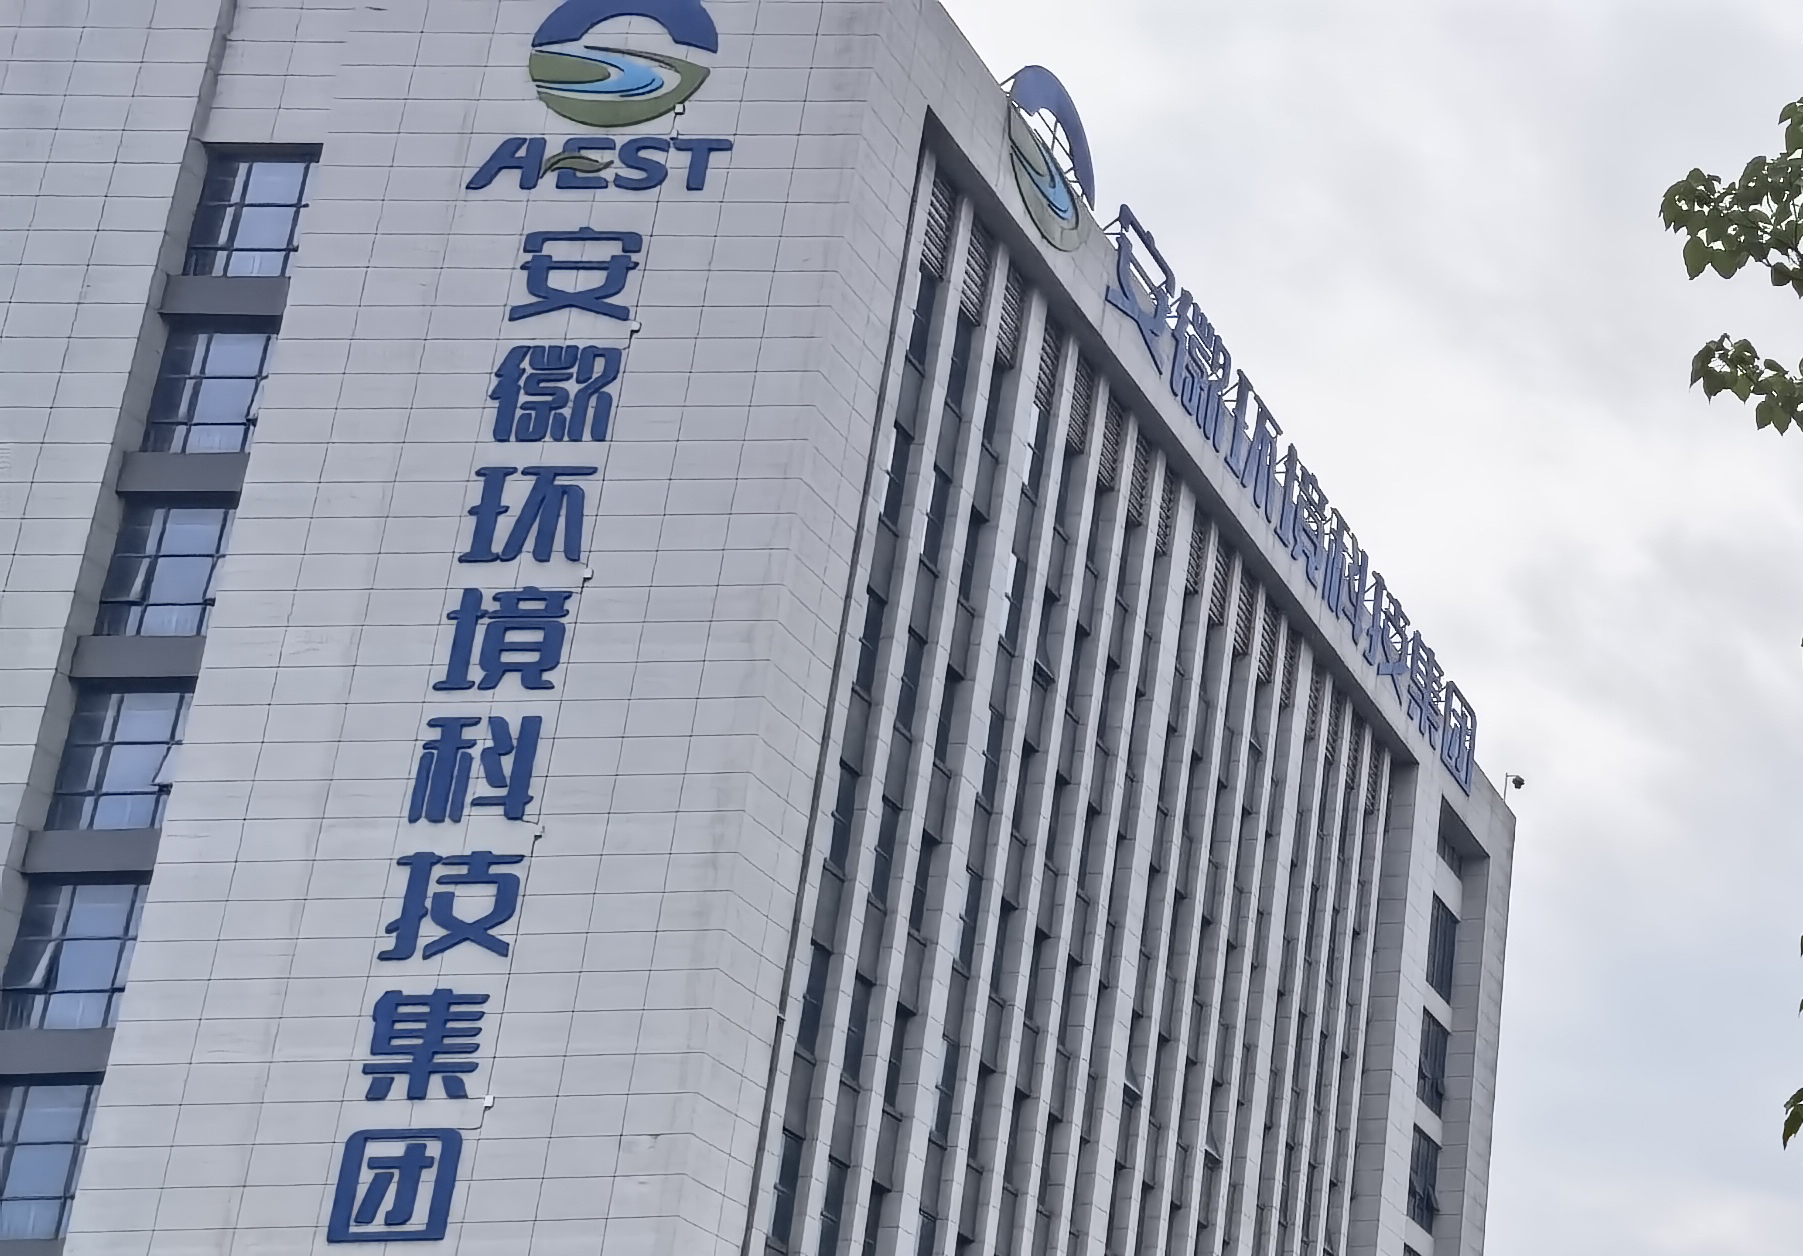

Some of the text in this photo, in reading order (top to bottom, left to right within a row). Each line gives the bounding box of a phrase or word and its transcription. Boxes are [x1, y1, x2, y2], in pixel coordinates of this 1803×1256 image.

[465, 136, 734, 192] AEST
[326, 226, 645, 1244] 安徽环境科技集团
[1105, 203, 1478, 796] 安徽环境科技集团
